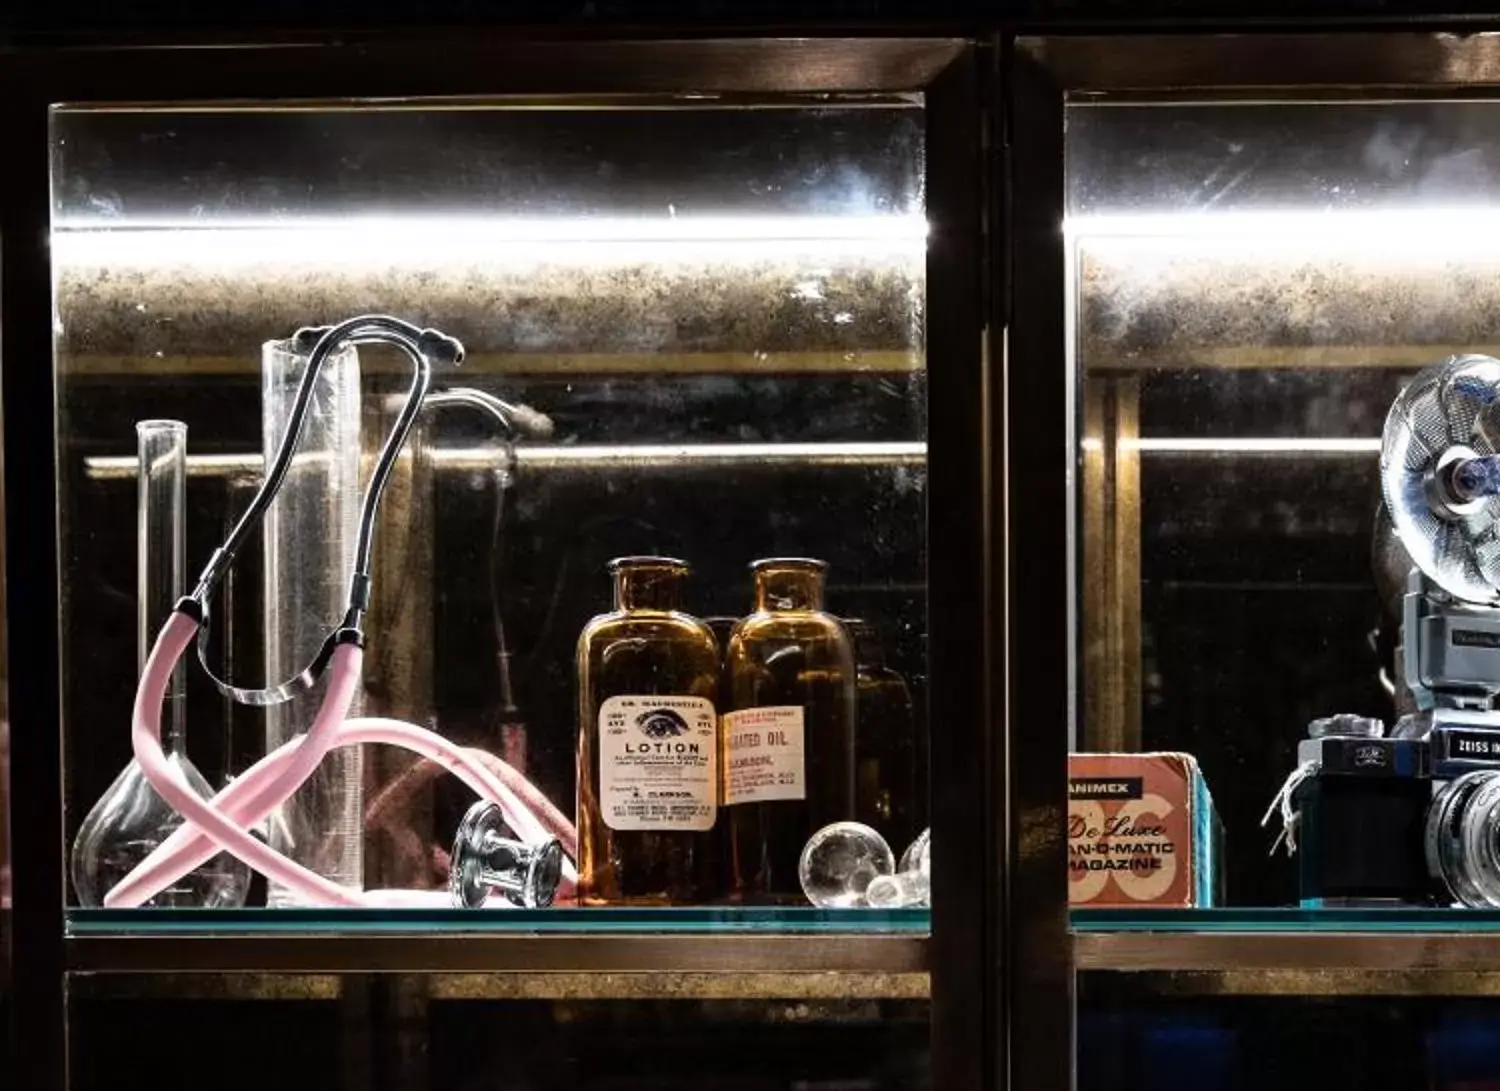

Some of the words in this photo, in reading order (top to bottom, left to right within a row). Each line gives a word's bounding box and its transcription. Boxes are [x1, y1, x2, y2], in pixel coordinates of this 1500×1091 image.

[767, 731, 788, 746] OIL
[625, 743, 699, 753] LOTION
[1459, 739, 1488, 753] ZEISS
